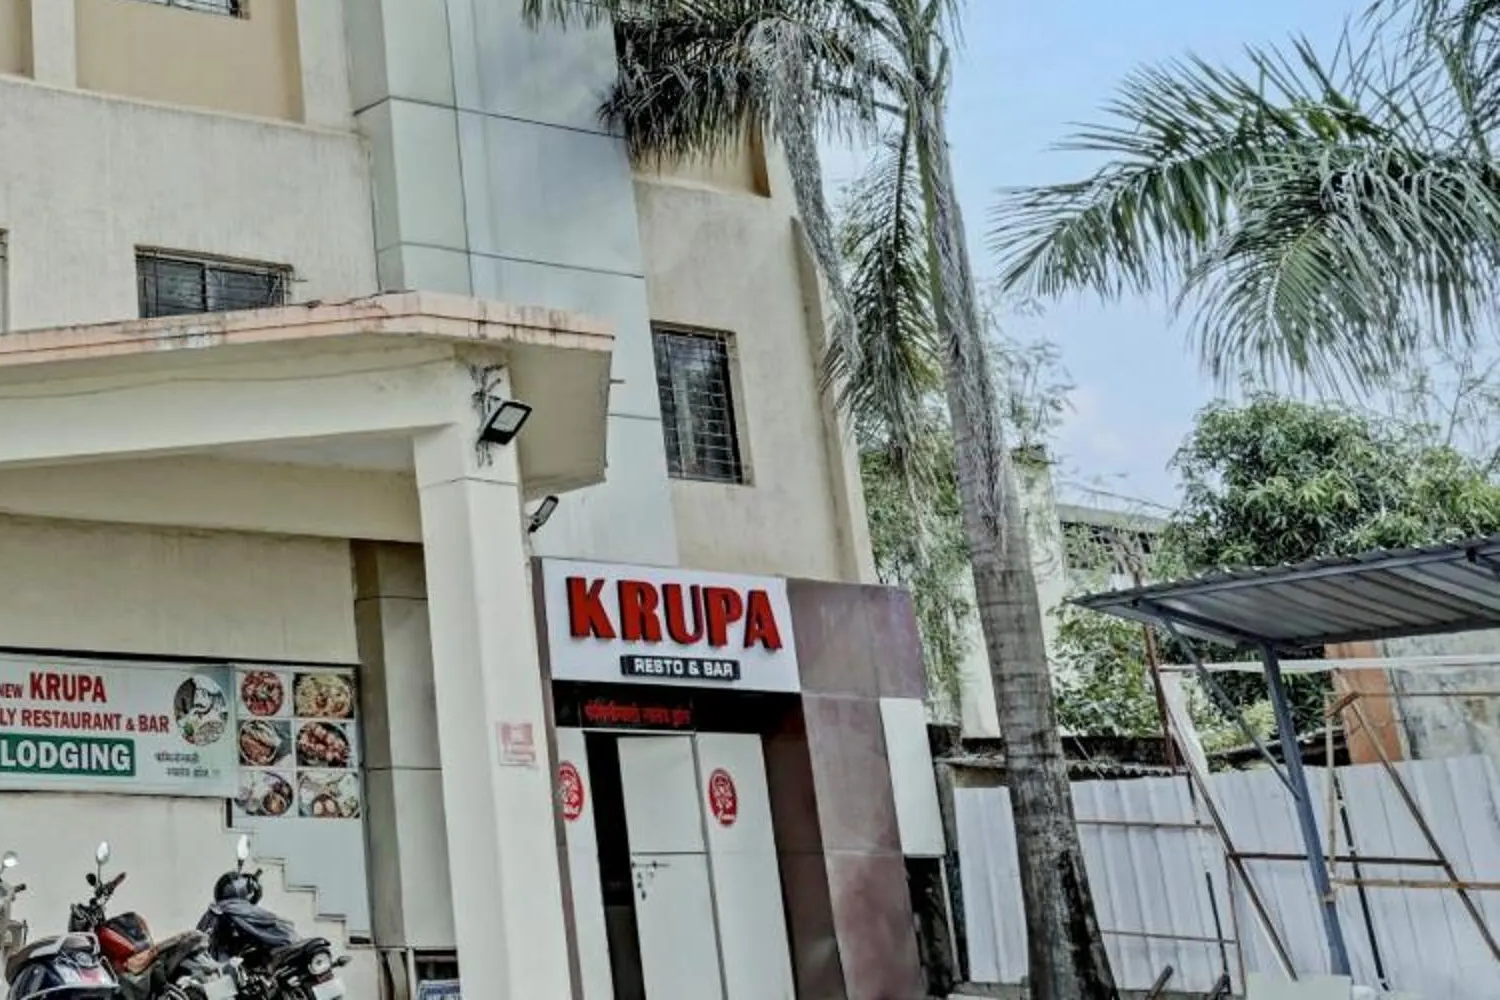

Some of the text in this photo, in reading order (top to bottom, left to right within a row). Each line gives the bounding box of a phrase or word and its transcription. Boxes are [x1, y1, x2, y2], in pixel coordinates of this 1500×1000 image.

[565, 576, 783, 651] KRUPA
[634, 658, 733, 677] RESTO & BAR
[29, 671, 108, 704] KRUPA
[21, 709, 124, 732] RESTAURANT
[125, 717, 137, 731] &
[138, 714, 170, 733] BAR
[0, 738, 131, 771] LODGING
